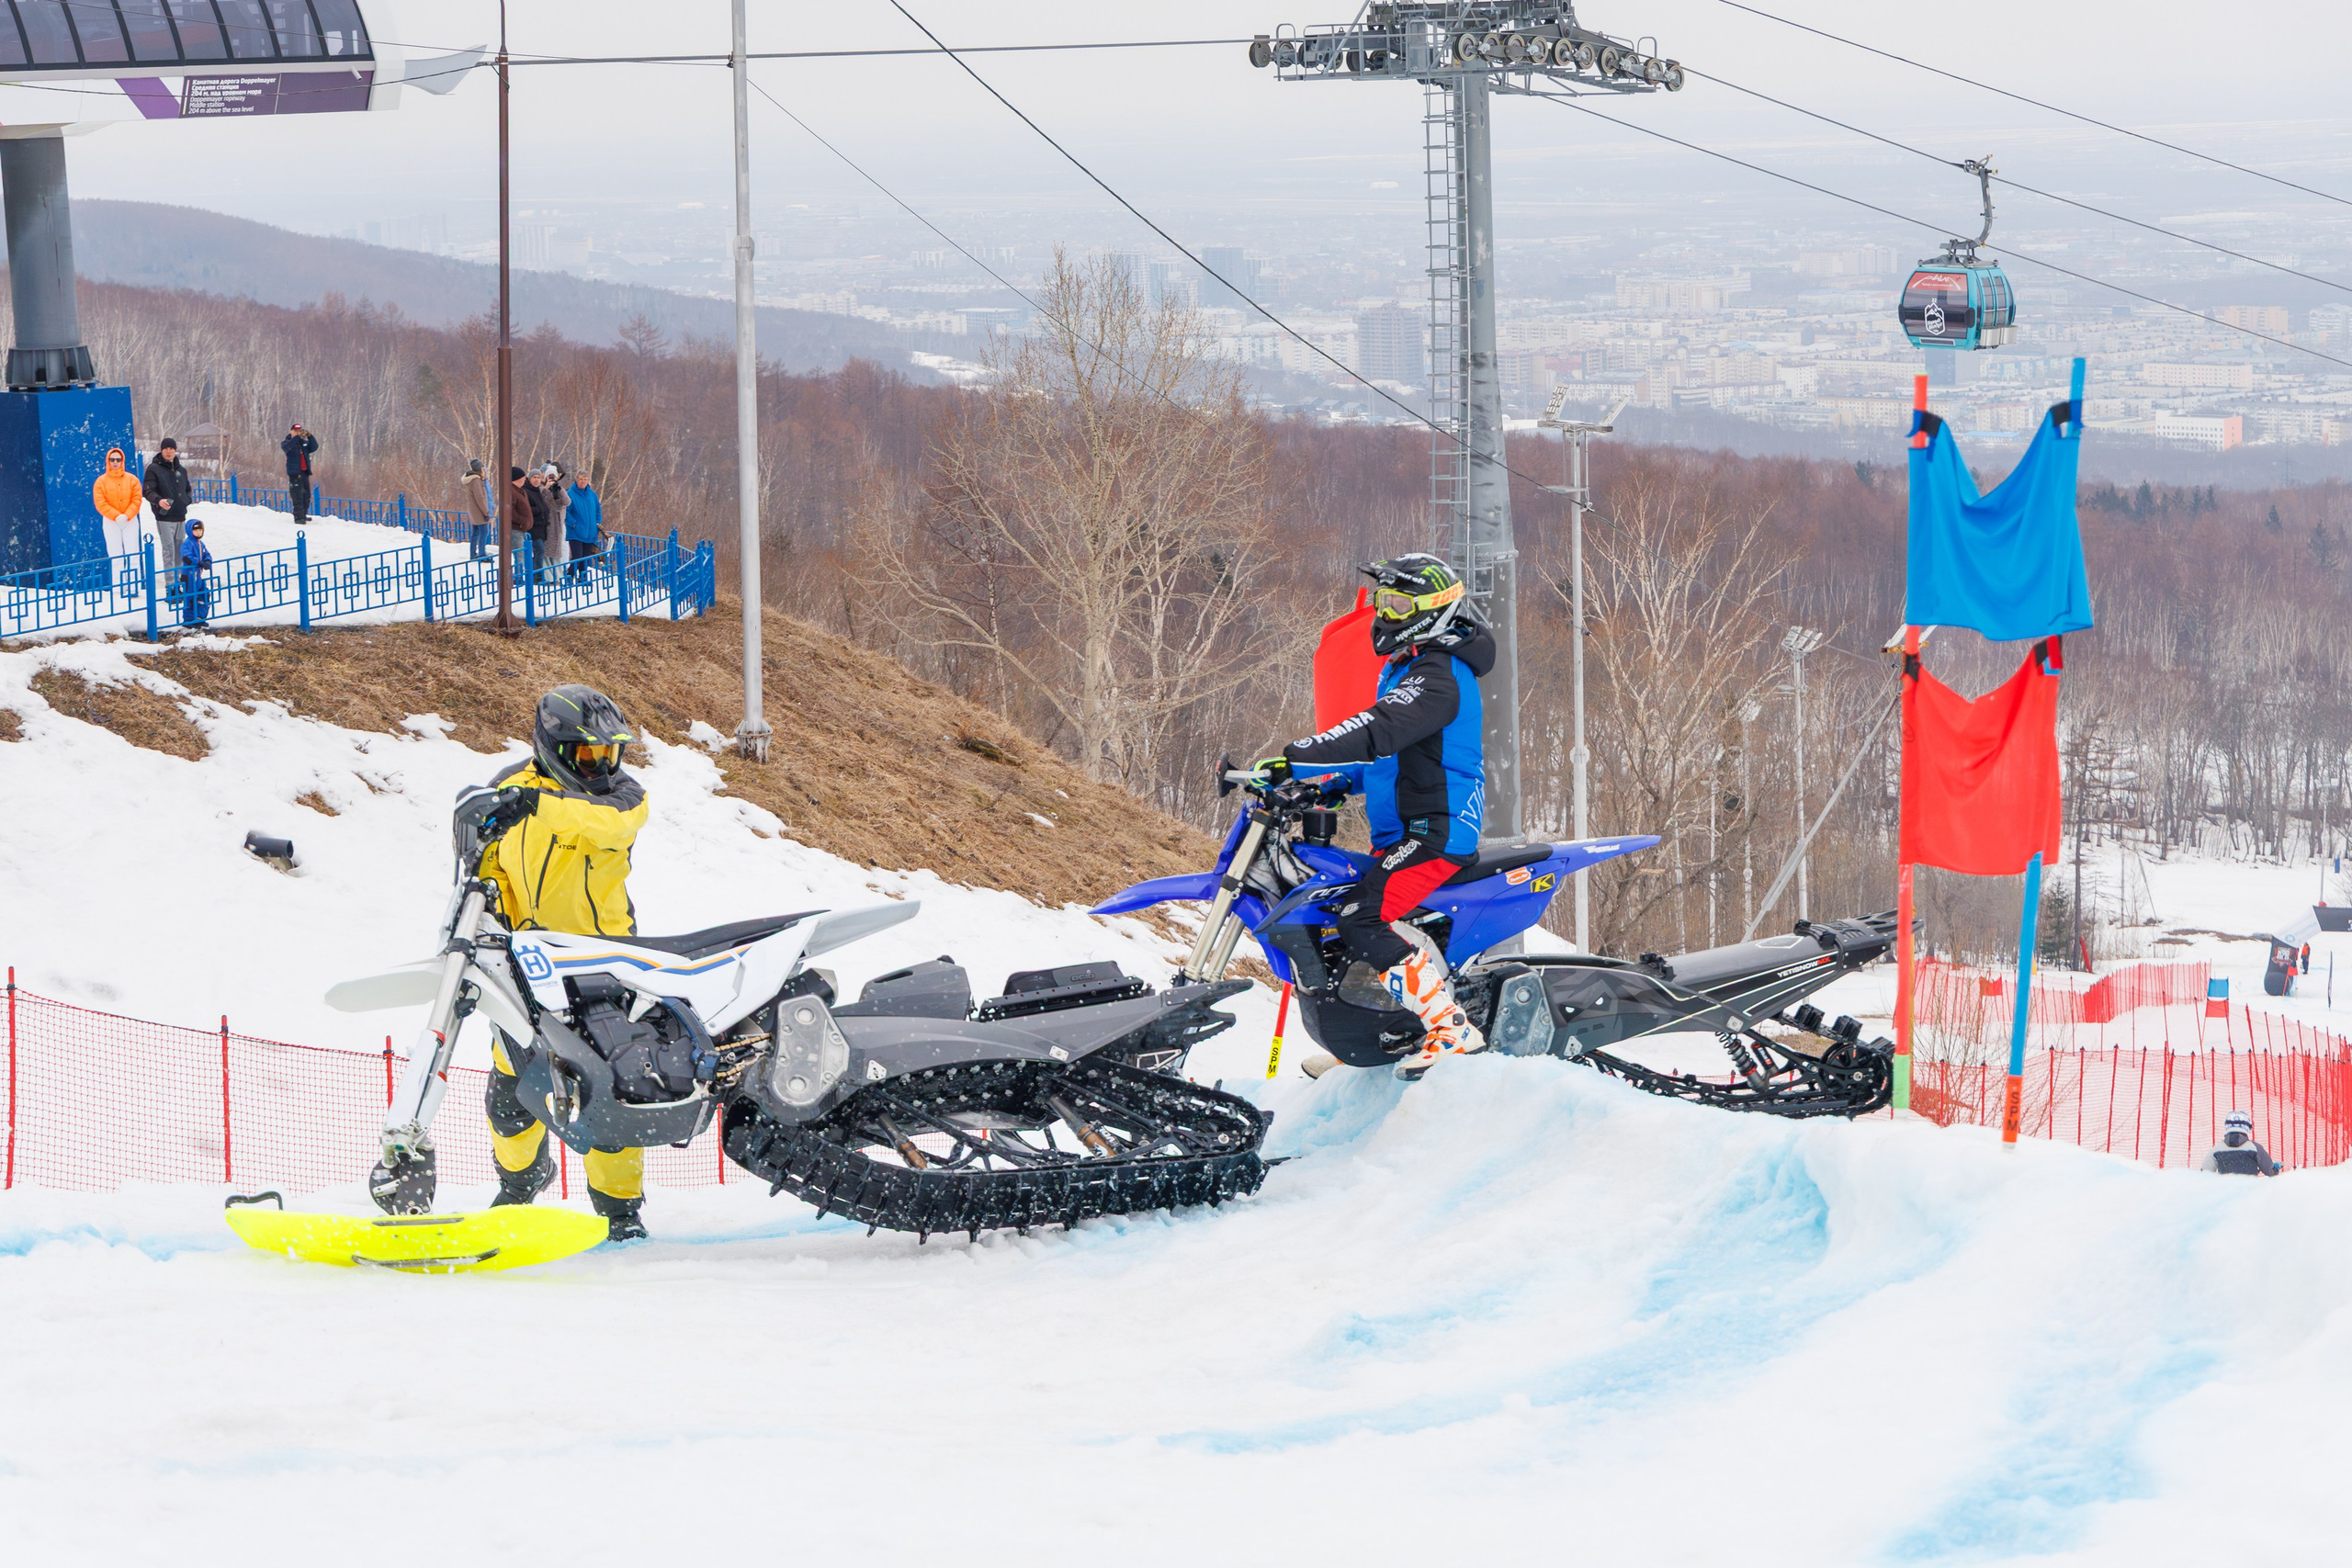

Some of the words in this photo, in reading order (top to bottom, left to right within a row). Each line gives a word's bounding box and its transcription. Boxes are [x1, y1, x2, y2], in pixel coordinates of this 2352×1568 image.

[1395, 616, 1433, 643] MONSTER
[1777, 956, 1831, 978] YETISNOWMX
[1268, 1046, 1279, 1074] SPM
[2007, 1091, 2020, 1132] SPM
